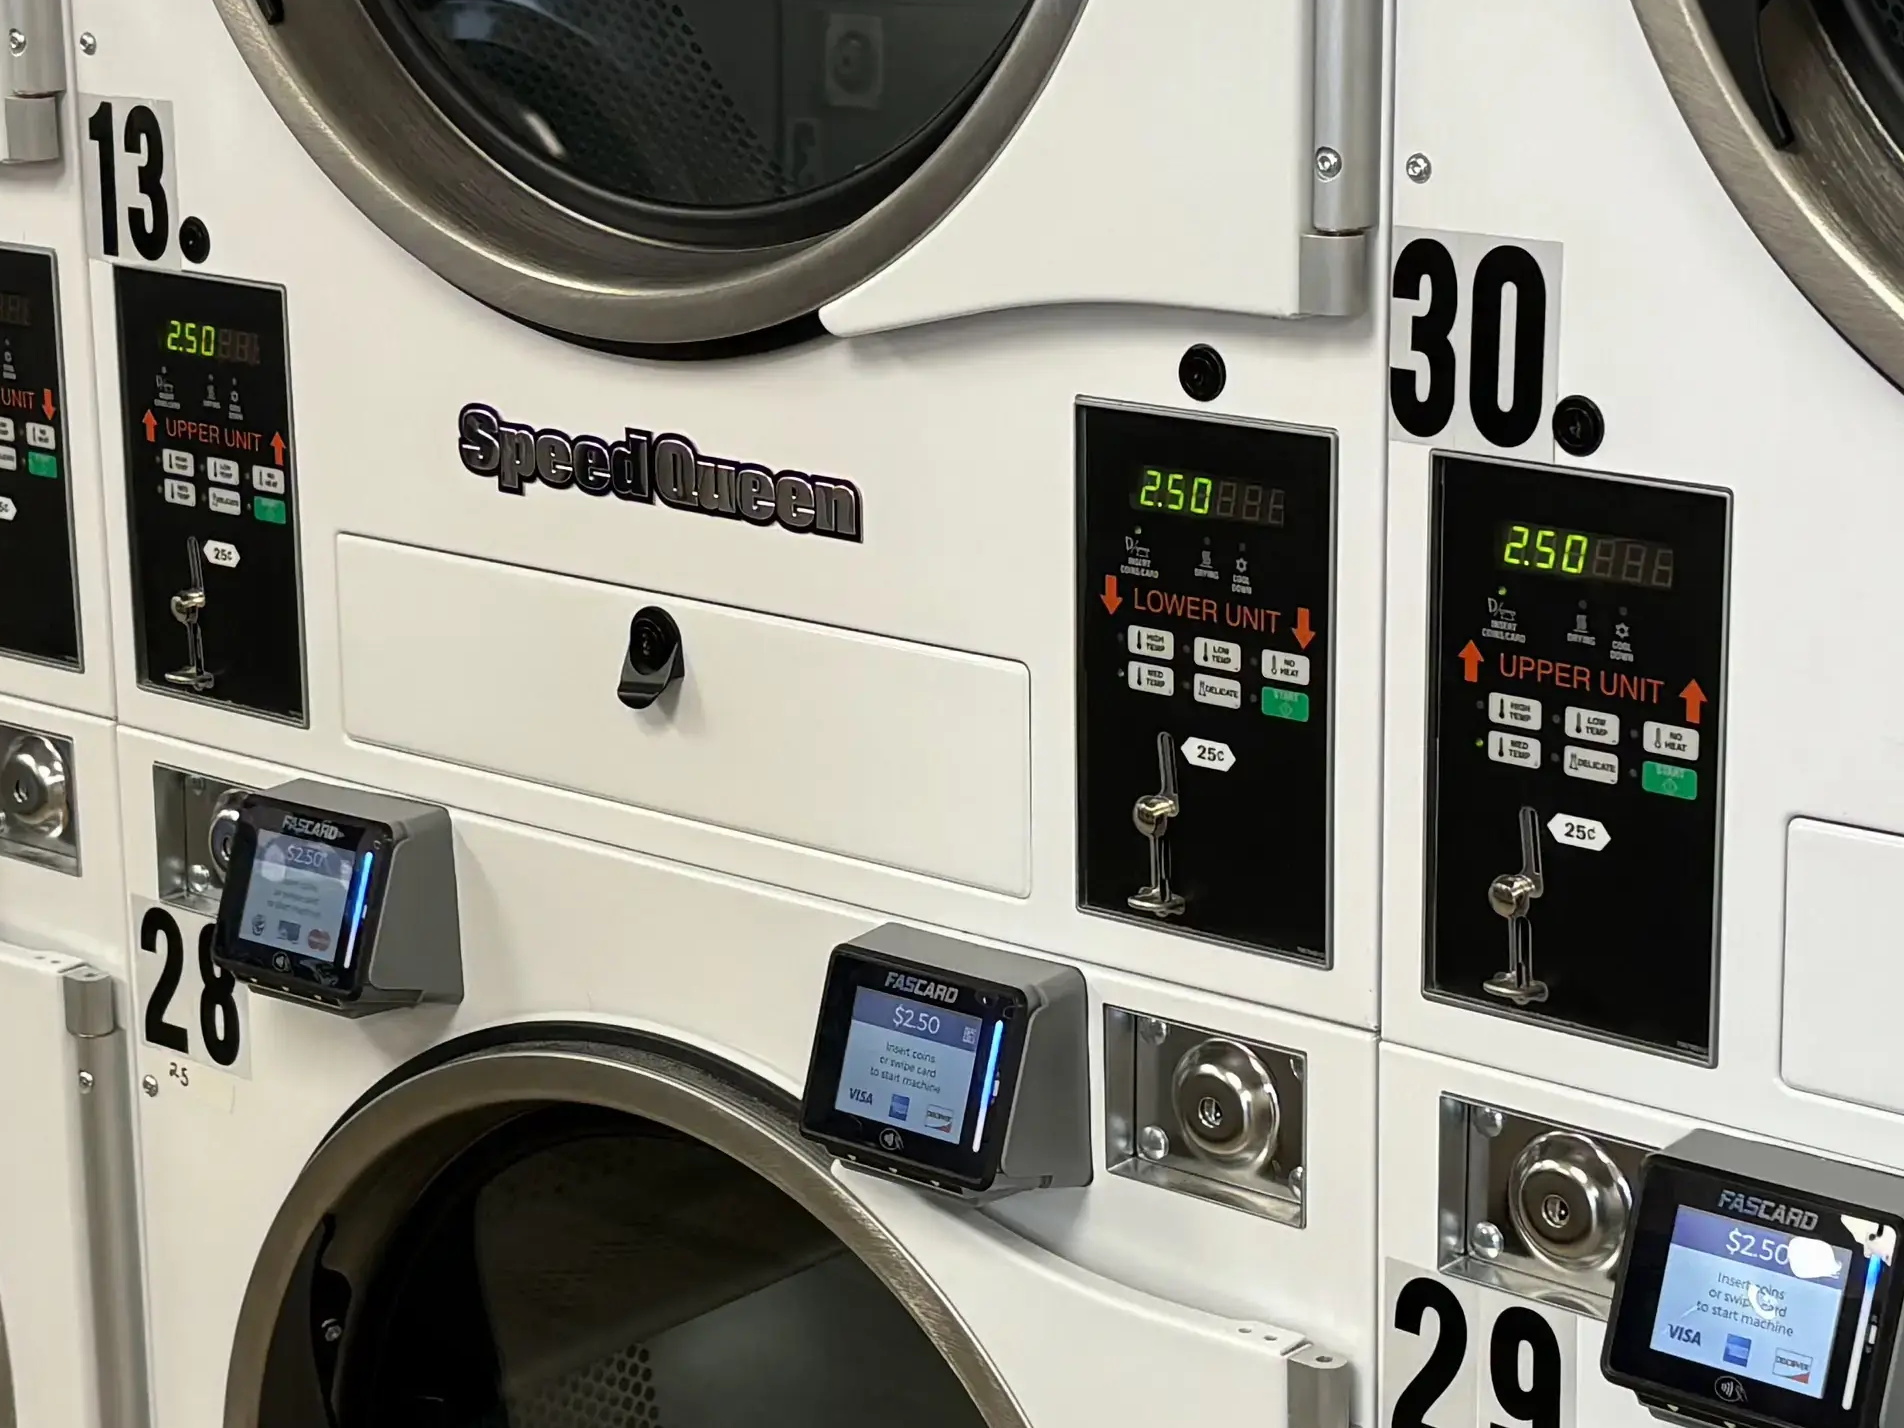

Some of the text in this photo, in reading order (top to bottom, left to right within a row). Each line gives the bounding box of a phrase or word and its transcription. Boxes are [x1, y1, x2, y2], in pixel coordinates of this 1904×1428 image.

[88, 100, 170, 262] 13
[166, 319, 216, 357] 2.50
[1389, 237, 1547, 448] 30
[0, 387, 35, 410] UNIT
[165, 416, 263, 452] UPPER UNIT
[458, 401, 865, 544] Speed Queen
[1139, 469, 1214, 515] 2.50
[1503, 525, 1589, 575] 2.50
[1133, 587, 1282, 634] LOWER UNIT
[1212, 645, 1230, 655] LOW
[1499, 652, 1665, 704] UPPER UNIT
[1204, 684, 1239, 699] DELICATE
[1509, 711, 1532, 723] TEMP
[1510, 701, 1532, 714] HIGH
[1585, 725, 1609, 738] TEMP
[1587, 716, 1607, 727] LOW
[1510, 740, 1530, 751] MED
[1664, 740, 1688, 753] HEAT
[1669, 731, 1683, 742] NO
[1508, 748, 1532, 760] TEMP
[1577, 758, 1617, 774] DELICATE
[281, 814, 339, 841] FASCARD
[1563, 821, 1597, 842] 25¢
[140, 906, 241, 1067] 28
[884, 971, 959, 1005] FASCARD
[892, 1003, 941, 1035] $2.50
[886, 1041, 936, 1064] Insert coins
[869, 1066, 879, 1077] to
[880, 1068, 901, 1084] start
[879, 1055, 937, 1079] or swipe card
[849, 1087, 874, 1106] VISA
[1717, 1188, 1819, 1232] FASCARD
[1725, 1227, 1790, 1266] $2.50
[1717, 1271, 1751, 1290] Insert
[1708, 1288, 1722, 1299] or
[1724, 1293, 1755, 1309] swip
[1696, 1300, 1794, 1337] to start machine
[1667, 1323, 1702, 1347] VISA
